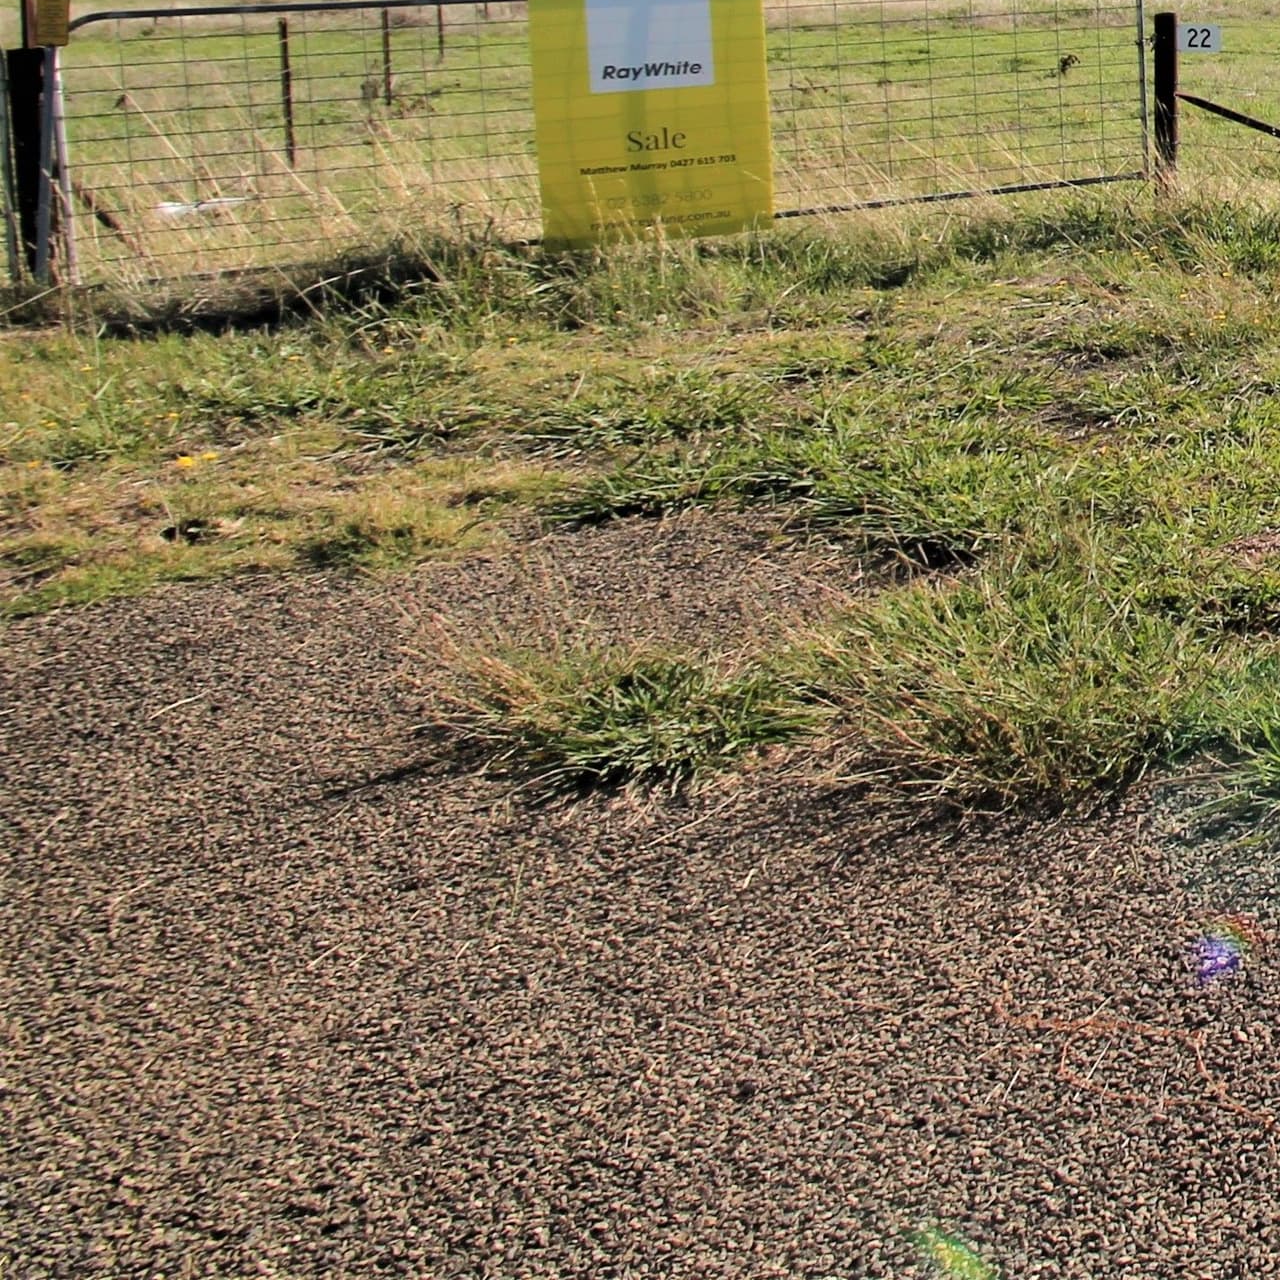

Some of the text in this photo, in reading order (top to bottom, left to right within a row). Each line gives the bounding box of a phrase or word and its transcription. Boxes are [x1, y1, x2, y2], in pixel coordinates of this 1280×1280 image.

[1187, 28, 1211, 48] 22
[602, 60, 702, 81] RayWhite
[627, 127, 687, 153] Sale
[580, 154, 736, 175] Matthew Murray 0427 615 703
